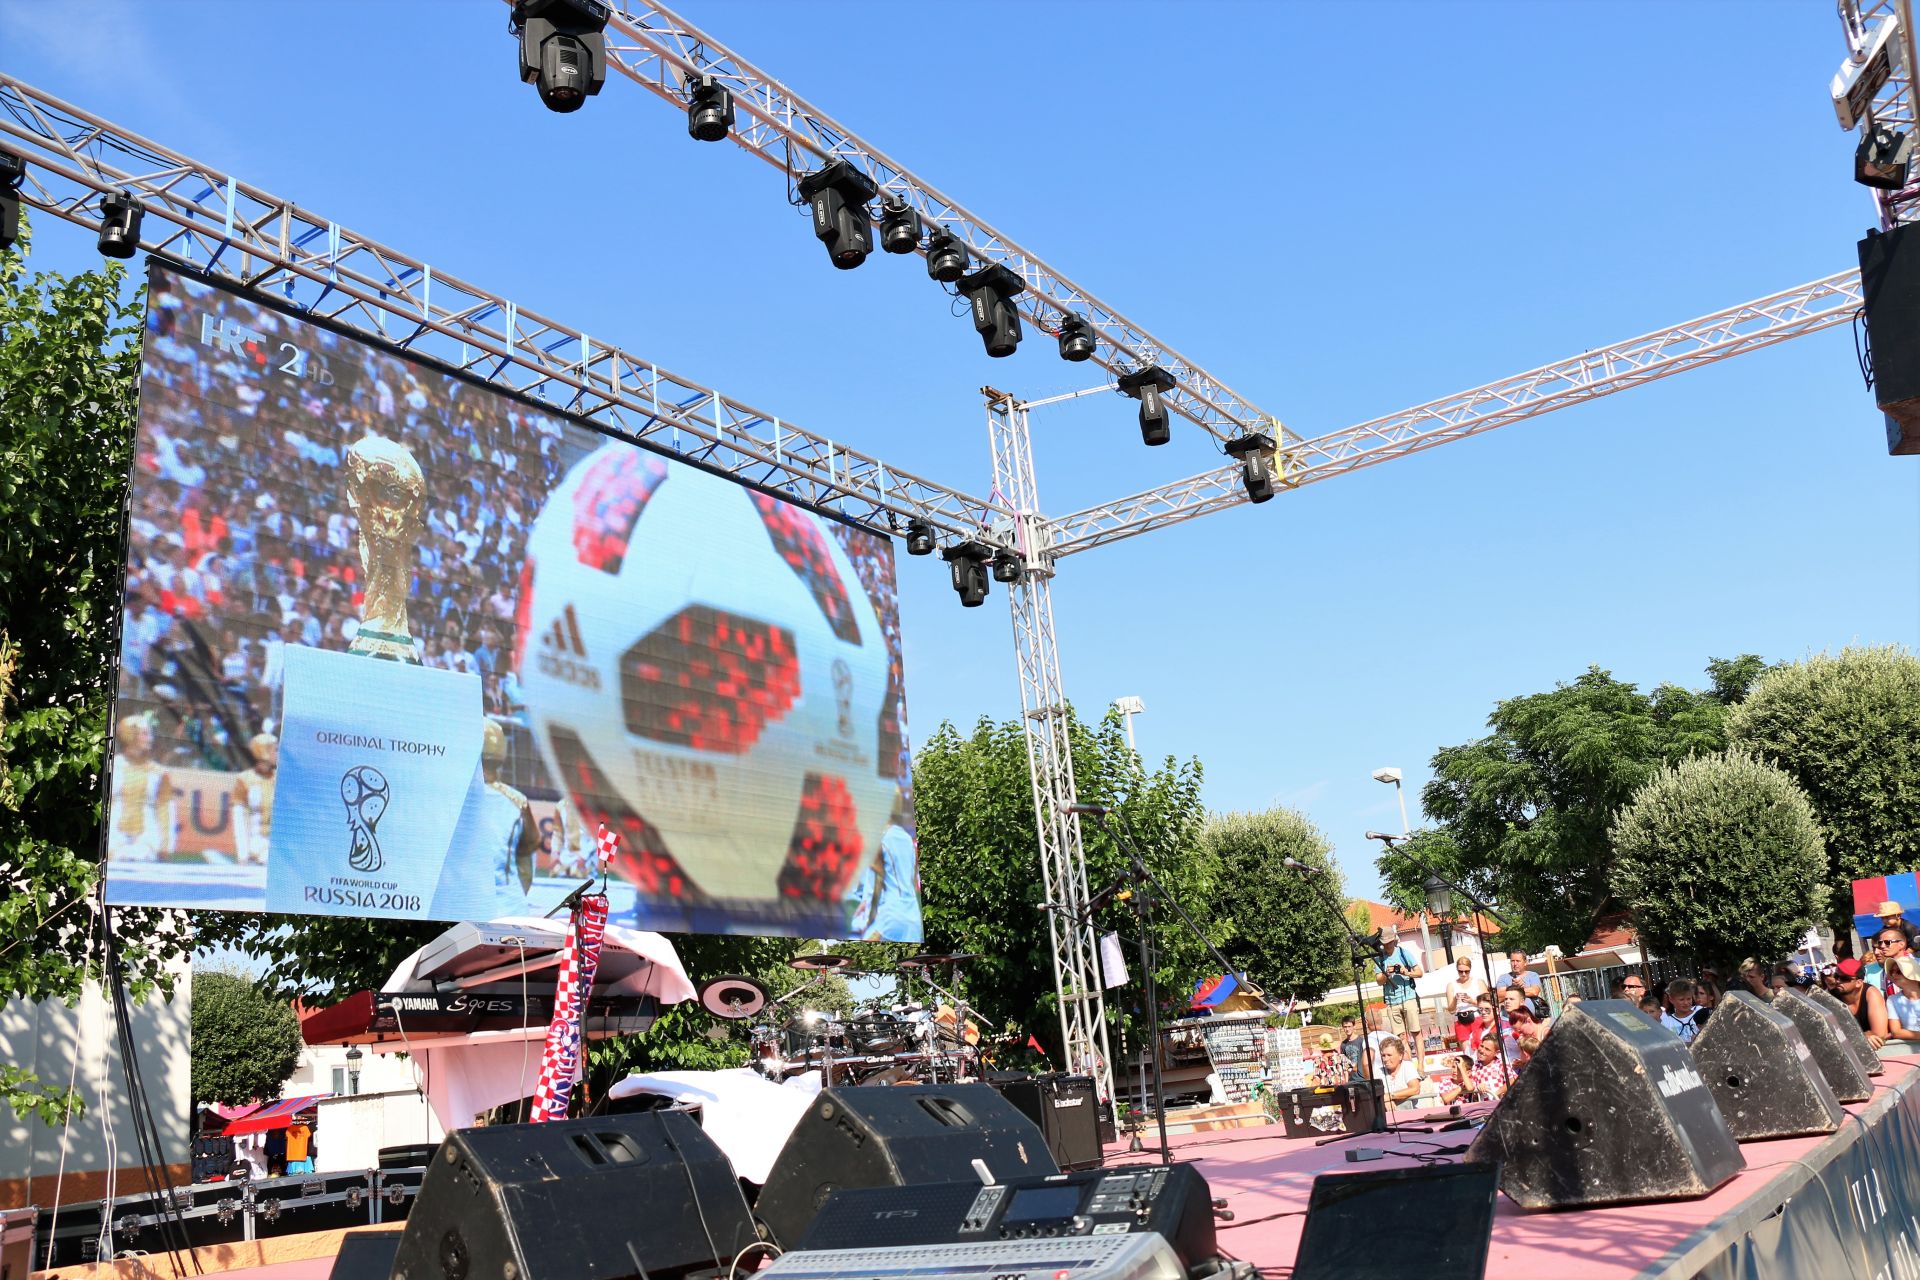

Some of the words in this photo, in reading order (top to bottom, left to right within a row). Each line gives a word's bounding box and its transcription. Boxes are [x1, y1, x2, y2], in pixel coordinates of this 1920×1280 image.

[201, 313, 267, 365] HRT
[279, 342, 301, 377] 2
[316, 731, 386, 750] ORIGINAL
[388, 739, 446, 757] TROPHY
[330, 877, 349, 886] FIFA
[350, 879, 380, 889] WORLD
[381, 881, 398, 890] CUP
[304, 886, 376, 908] RUSSIA
[379, 892, 421, 912] 2018
[402, 997, 439, 1011] YAMAHA
[487, 1000, 513, 1011] ES
[872, 1209, 919, 1219] TF5
